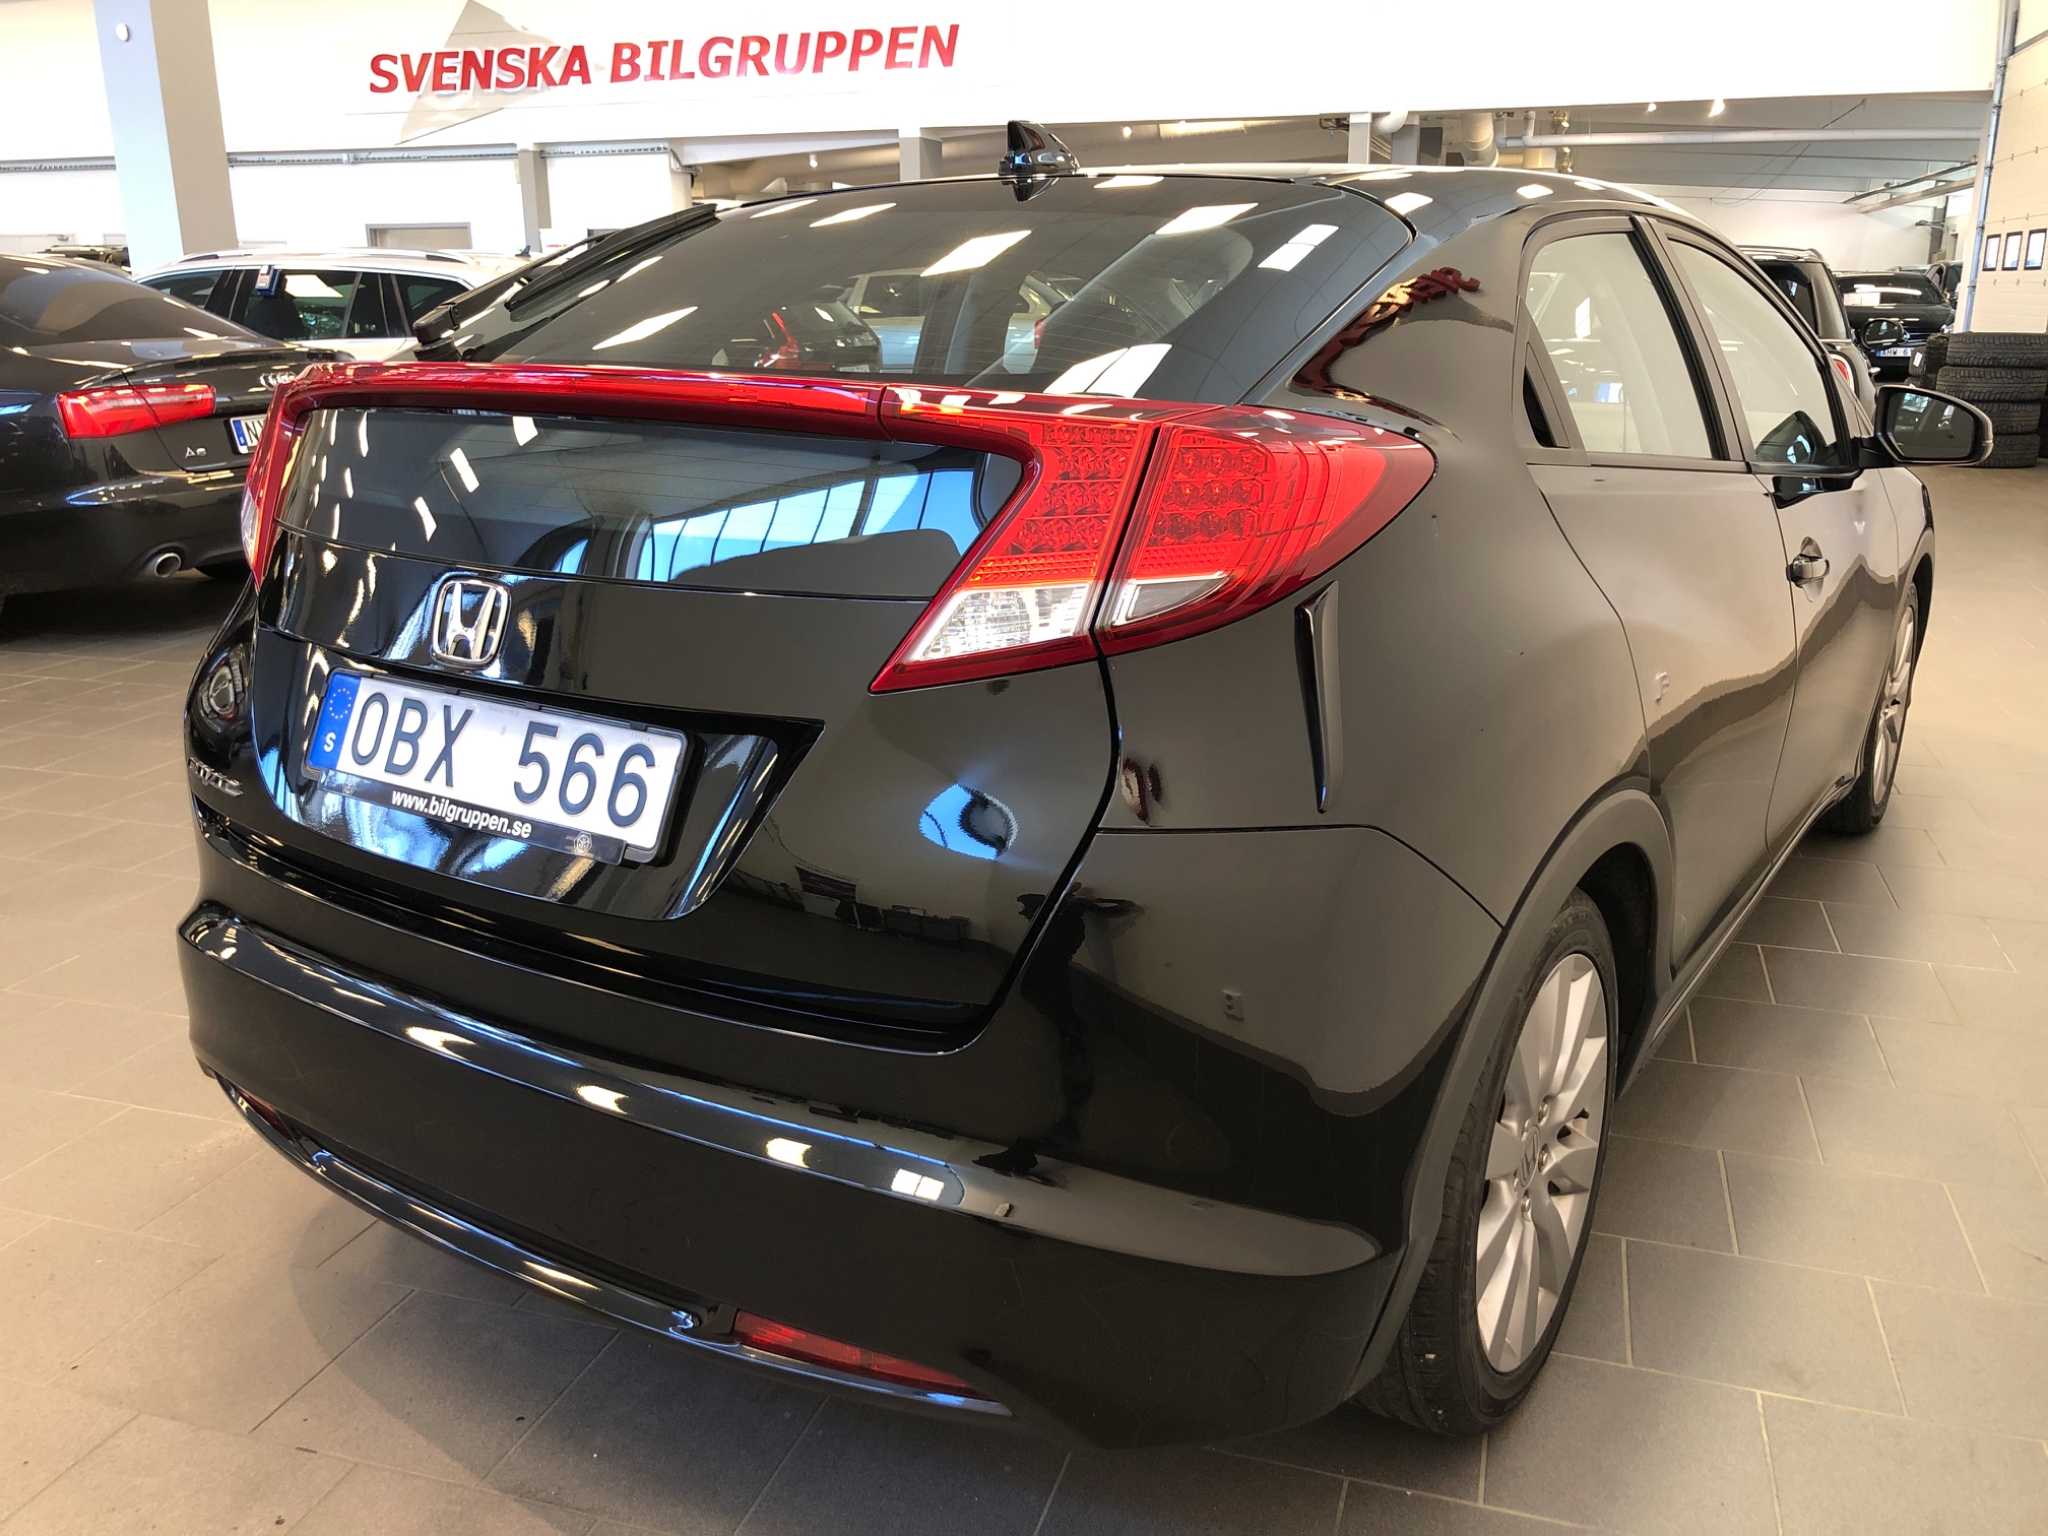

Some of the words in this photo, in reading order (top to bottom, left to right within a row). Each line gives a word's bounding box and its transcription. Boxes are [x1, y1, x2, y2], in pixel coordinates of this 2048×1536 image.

[370, 45, 592, 93] SVENSKA
[610, 24, 960, 83] BILGRUPPEN
[324, 732, 336, 752] S
[351, 691, 474, 788] OBX
[513, 720, 657, 828] 566
[391, 790, 532, 838] www.bilgruppen.se
